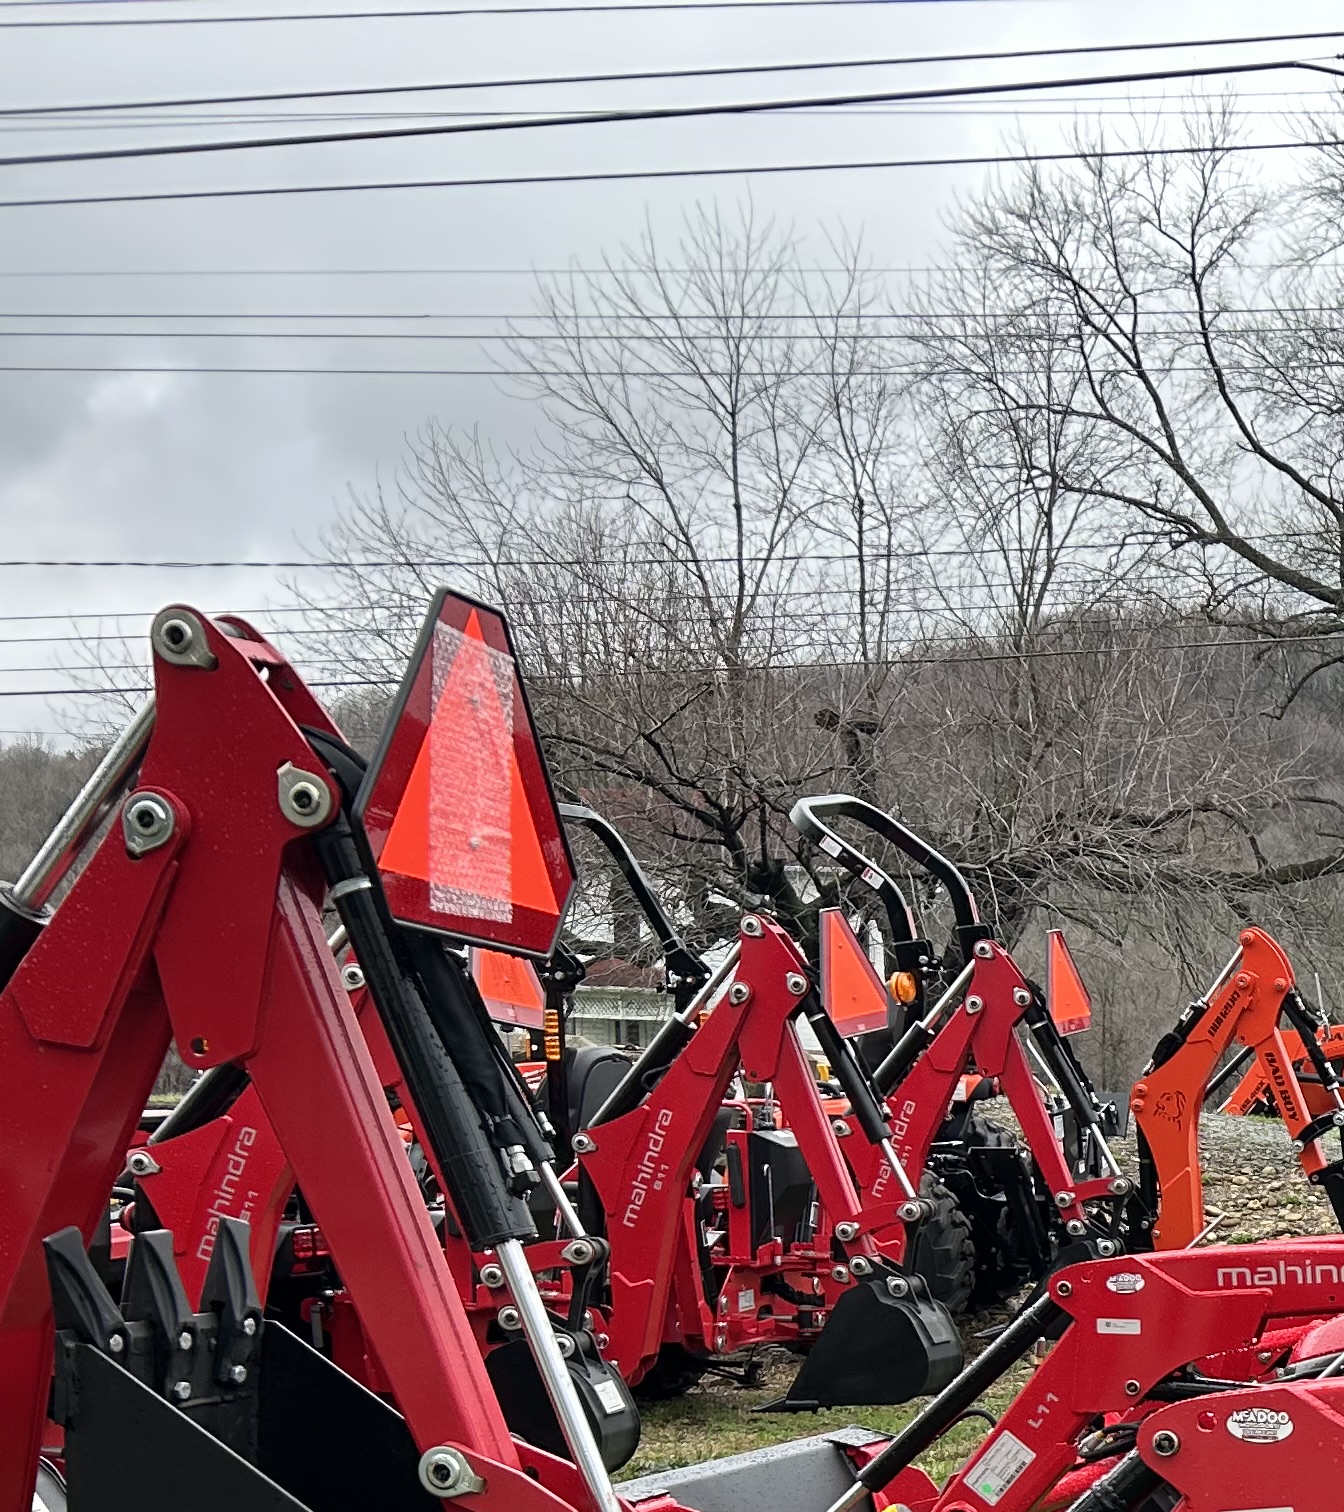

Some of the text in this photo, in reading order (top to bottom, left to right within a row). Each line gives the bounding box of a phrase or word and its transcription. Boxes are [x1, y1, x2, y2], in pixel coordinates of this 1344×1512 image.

[196, 1126, 258, 1262] mahindra
[622, 1109, 673, 1228] mahindra
[872, 1100, 916, 1198] mandra
[1027, 1392, 1060, 1429] L11
